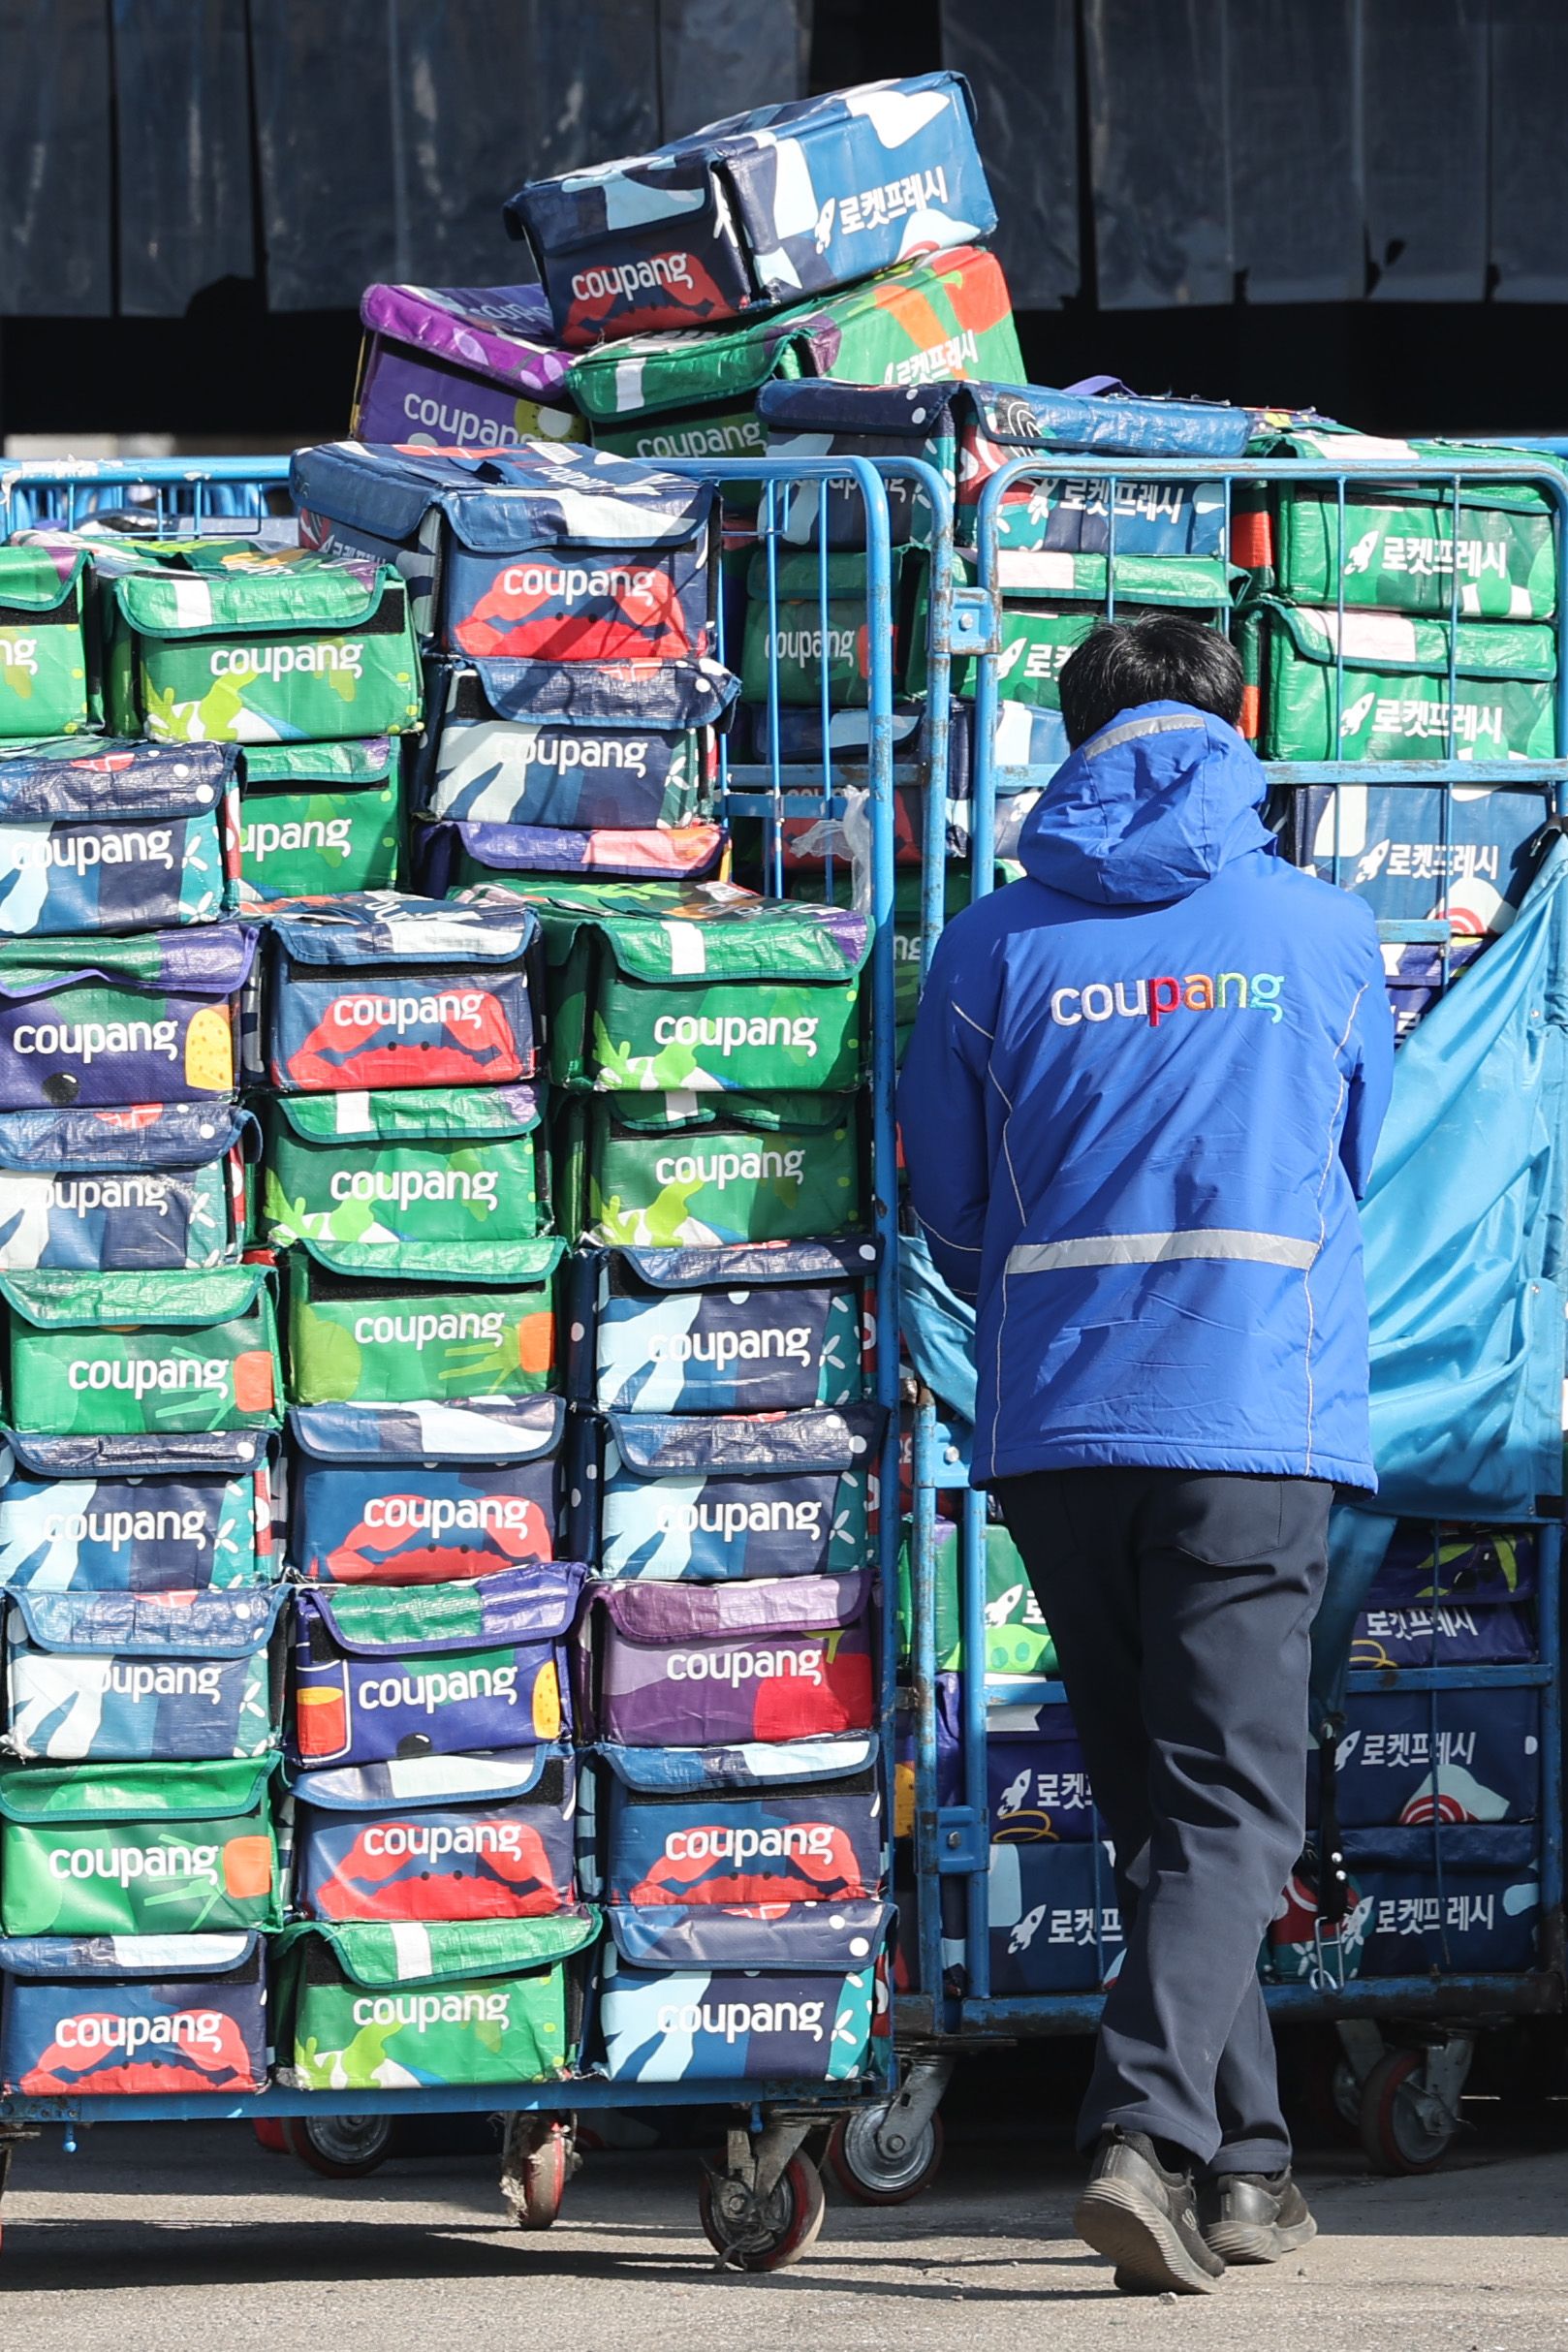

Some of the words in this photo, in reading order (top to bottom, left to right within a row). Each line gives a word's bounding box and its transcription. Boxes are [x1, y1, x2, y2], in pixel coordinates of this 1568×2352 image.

[839, 166, 949, 235] 로켓프레시
[571, 252, 694, 301] coupang
[637, 422, 768, 457] coupang
[1059, 477, 1184, 524] 로켓프레시
[1381, 536, 1506, 579] 로켓프레시
[503, 567, 656, 607] coupang
[210, 643, 364, 682] coupang
[1371, 698, 1503, 744] 로켓프레시
[495, 738, 648, 779] coupang
[11, 830, 174, 876] coupang
[239, 818, 353, 862] upang
[1386, 843, 1499, 881] 로켓프레시
[332, 993, 485, 1035] coupang
[1051, 972, 1285, 1027] coupang
[13, 1019, 179, 1064] coupang
[653, 1015, 820, 1056] coupang
[655, 1148, 806, 1190] coupang
[330, 1170, 499, 1211] coupang
[355, 1311, 505, 1351] coupang
[647, 1327, 812, 1371] coupang
[68, 1358, 231, 1400] coupang
[42, 1510, 207, 1552] coupang
[363, 1498, 530, 1540] coupang
[655, 1500, 823, 1543] coupang
[667, 1647, 823, 1689] coupang
[359, 1665, 519, 1714] coupang
[1360, 1731, 1476, 1768] 로켓프레시
[363, 1825, 522, 1865] coupang
[665, 1825, 835, 1868] coupang
[48, 1844, 220, 1889] coupang
[1048, 1907, 1123, 1947] 로켓프
[1375, 1894, 1494, 1936] 로켓프레시
[353, 1992, 511, 2033] coupang
[657, 2001, 825, 2044] coupang
[54, 2012, 224, 2056] coupang
